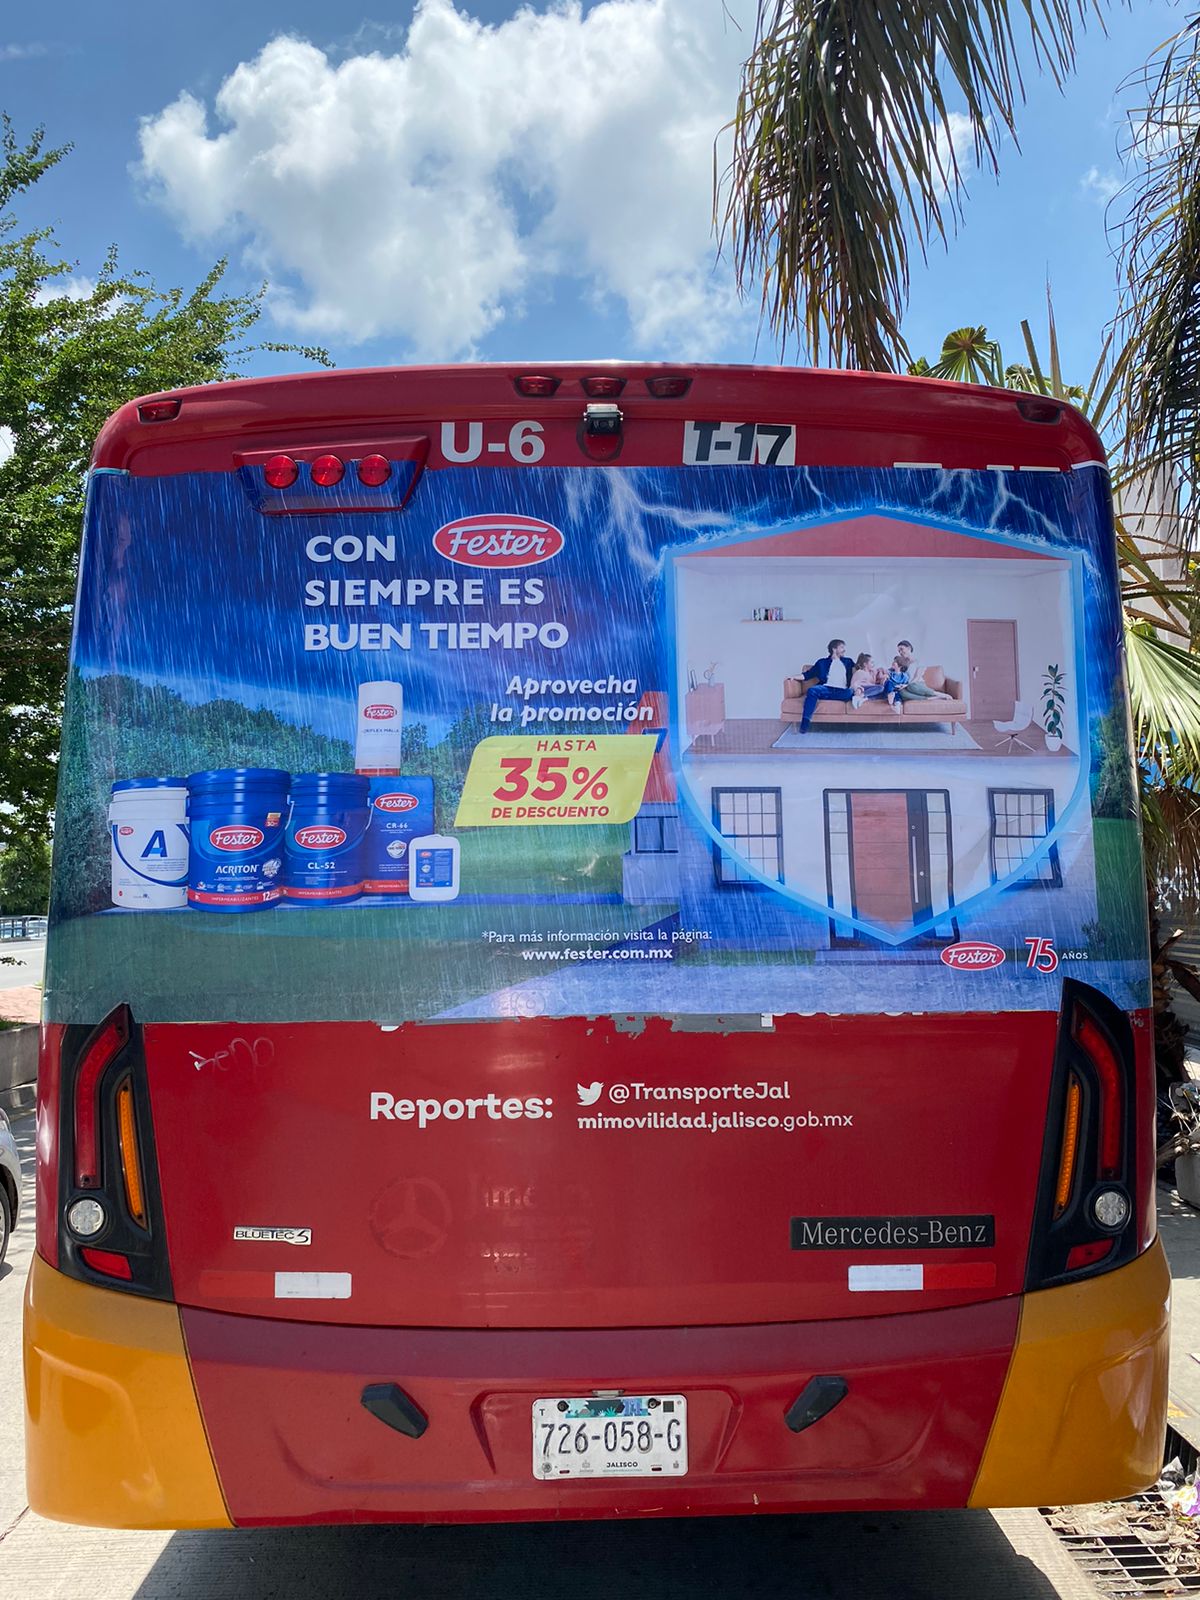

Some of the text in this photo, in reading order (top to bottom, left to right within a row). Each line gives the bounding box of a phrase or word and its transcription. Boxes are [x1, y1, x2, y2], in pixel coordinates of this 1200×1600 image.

[440, 421, 545, 464] U-6
[693, 421, 792, 465] T-17
[305, 535, 396, 563] CON
[304, 578, 545, 607] SIEMPRE ES
[304, 622, 569, 651] BUEN TIEMPO
[505, 675, 637, 699] Aprovecha
[491, 702, 654, 726] la promoción
[536, 740, 597, 752] HASTA
[493, 757, 609, 802] 35%
[491, 806, 609, 819] DE DESCUENTO
[141, 830, 168, 858] A
[215, 864, 259, 876] ACRITON
[519, 931, 543, 942] más
[547, 929, 620, 942] información
[623, 929, 654, 941] visita
[658, 928, 668, 940] la
[671, 929, 713, 945] página:
[522, 947, 673, 960] www.fester.com.mx
[1025, 937, 1058, 973] 75
[1061, 951, 1088, 960] AÑOS
[608, 1081, 791, 1104] @TransporteJal
[369, 1091, 553, 1128] Reportes:
[577, 1110, 854, 1133] mimovilidad.jalisco.gob.mx
[800, 1220, 986, 1246] Mercedes-Benz
[541, 1418, 681, 1456] 726-058-G
